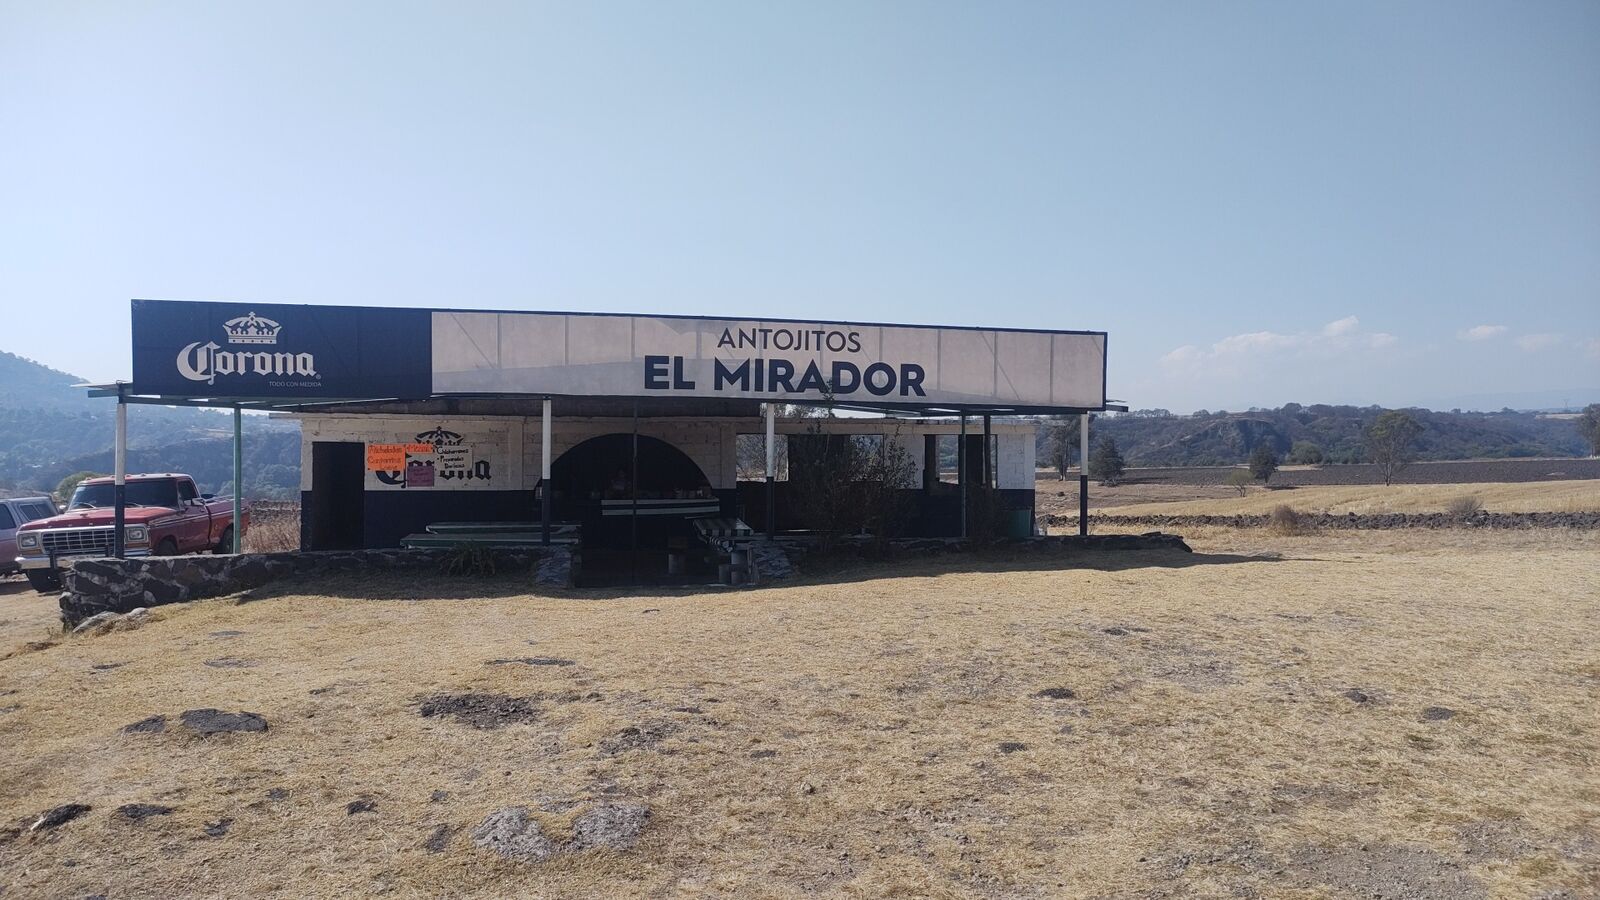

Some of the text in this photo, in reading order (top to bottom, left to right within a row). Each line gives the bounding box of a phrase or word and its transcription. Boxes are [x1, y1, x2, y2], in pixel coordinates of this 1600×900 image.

[717, 327, 861, 353] ANTOJITOS
[176, 341, 317, 386] Corona
[644, 355, 927, 397] EL MIRADOR
